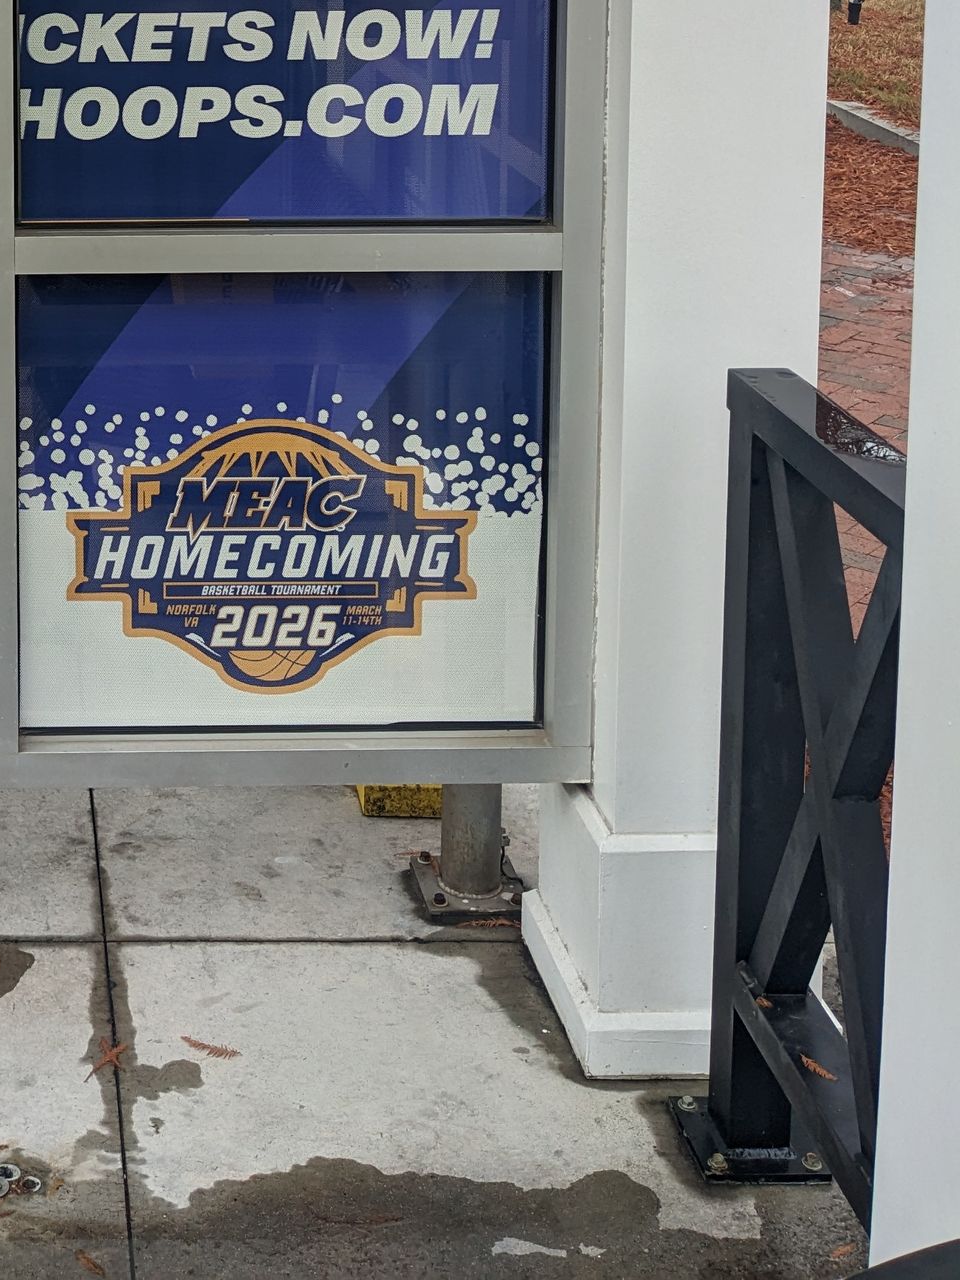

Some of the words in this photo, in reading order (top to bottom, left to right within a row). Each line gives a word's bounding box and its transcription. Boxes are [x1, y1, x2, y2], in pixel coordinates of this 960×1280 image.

[286, 8, 501, 62] NOW!
[166, 474, 366, 535] MEAC
[93, 533, 455, 580] HOMECOMING
[201, 585, 268, 597] BASKETBALL
[270, 584, 342, 597] TOURNAMENT
[165, 604, 218, 616] NORFOLK
[345, 605, 383, 616] MARCH
[184, 617, 200, 628] VA
[209, 605, 343, 648] 2026
[342, 615, 383, 627] 11-14TH
